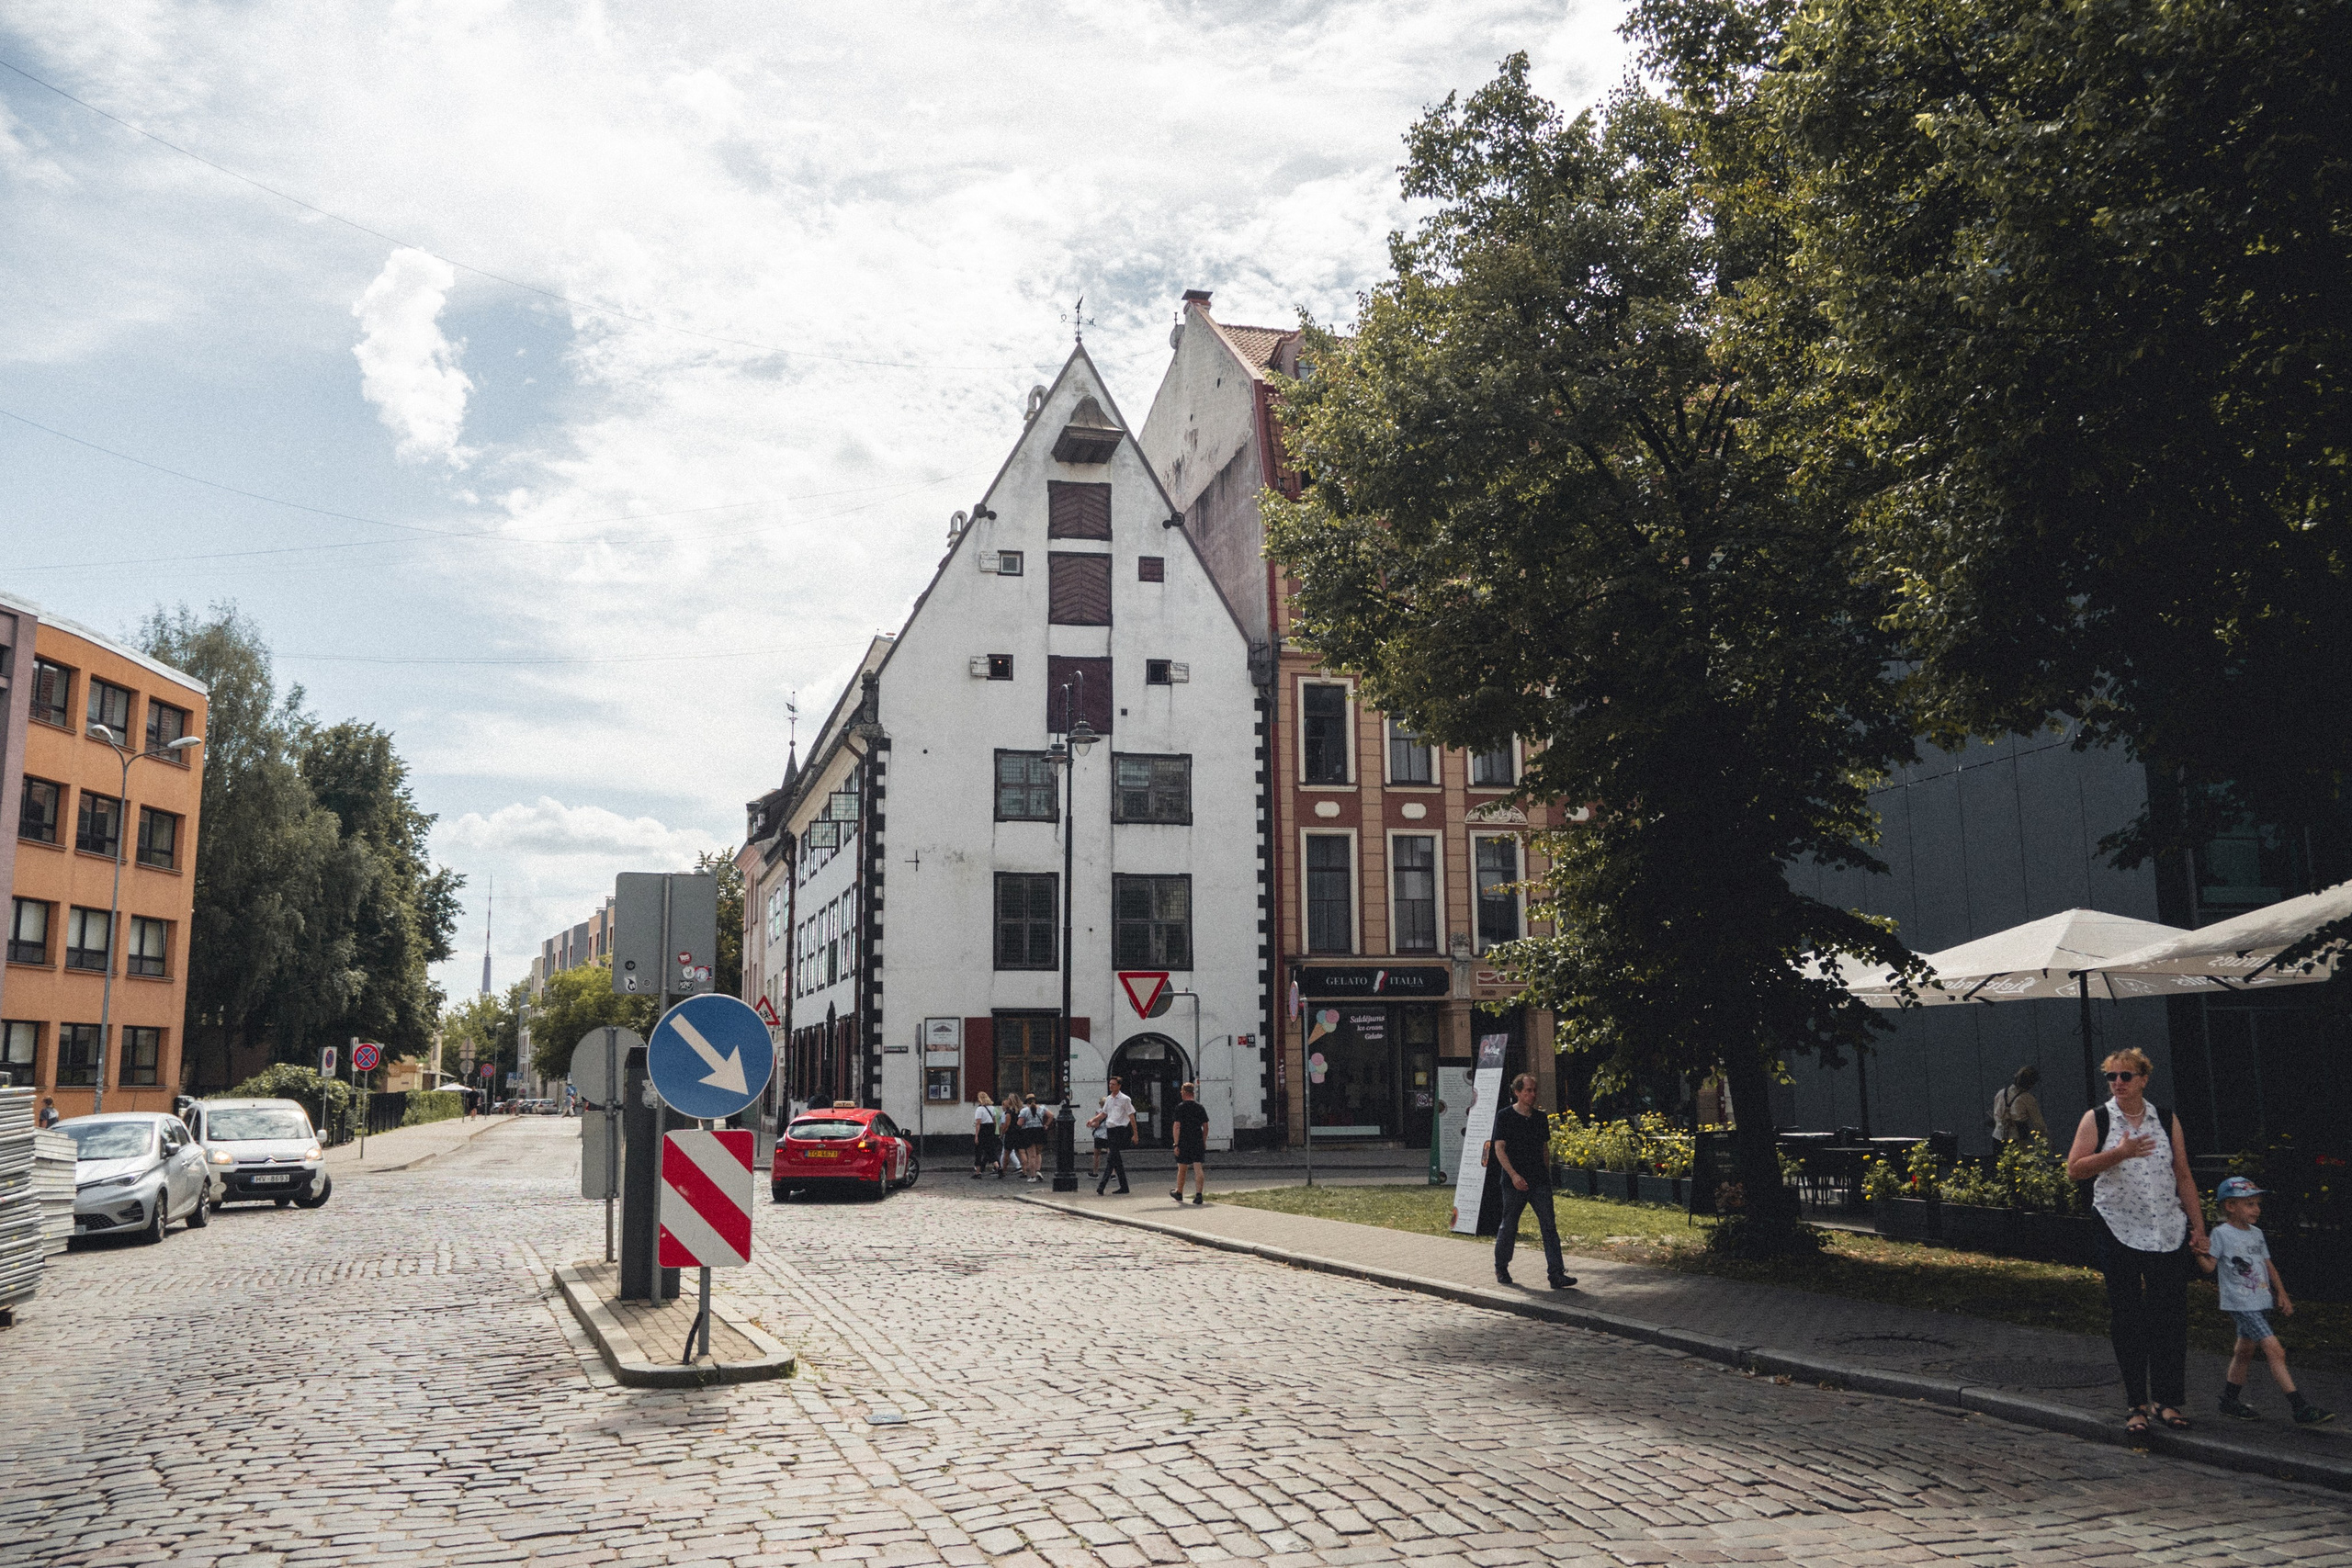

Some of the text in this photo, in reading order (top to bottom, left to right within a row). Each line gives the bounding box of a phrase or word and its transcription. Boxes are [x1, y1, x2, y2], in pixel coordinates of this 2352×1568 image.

[1326, 976, 1424, 986] GELATO ITALIA
[1350, 1014, 1385, 1023] Saldējums
[255, 1175, 288, 1183] HV-8693
